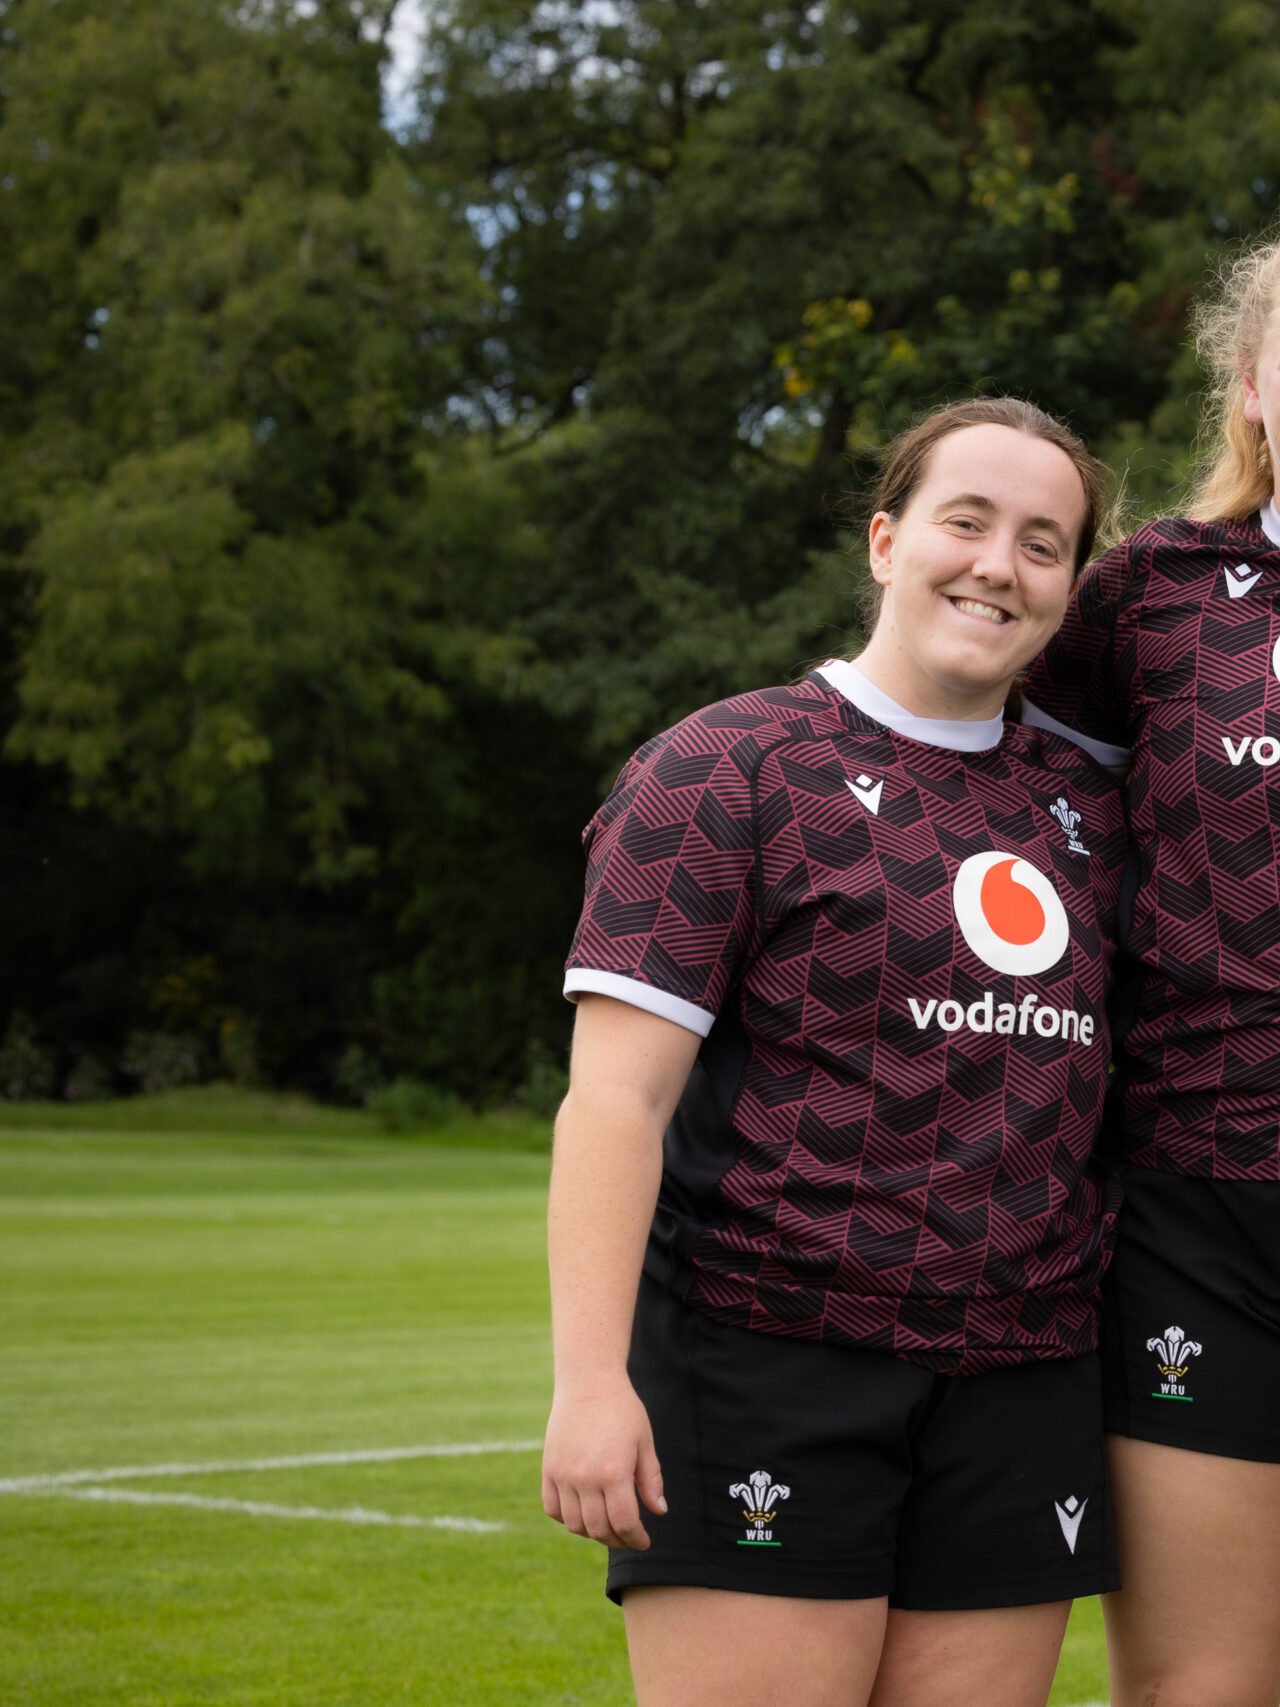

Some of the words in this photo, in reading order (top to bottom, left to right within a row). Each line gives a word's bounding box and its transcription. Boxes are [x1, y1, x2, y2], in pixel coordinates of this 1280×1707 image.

[907, 992, 1095, 1046] vodafone
[1160, 1383, 1185, 1395] WRU
[746, 1529, 772, 1540] WRU
